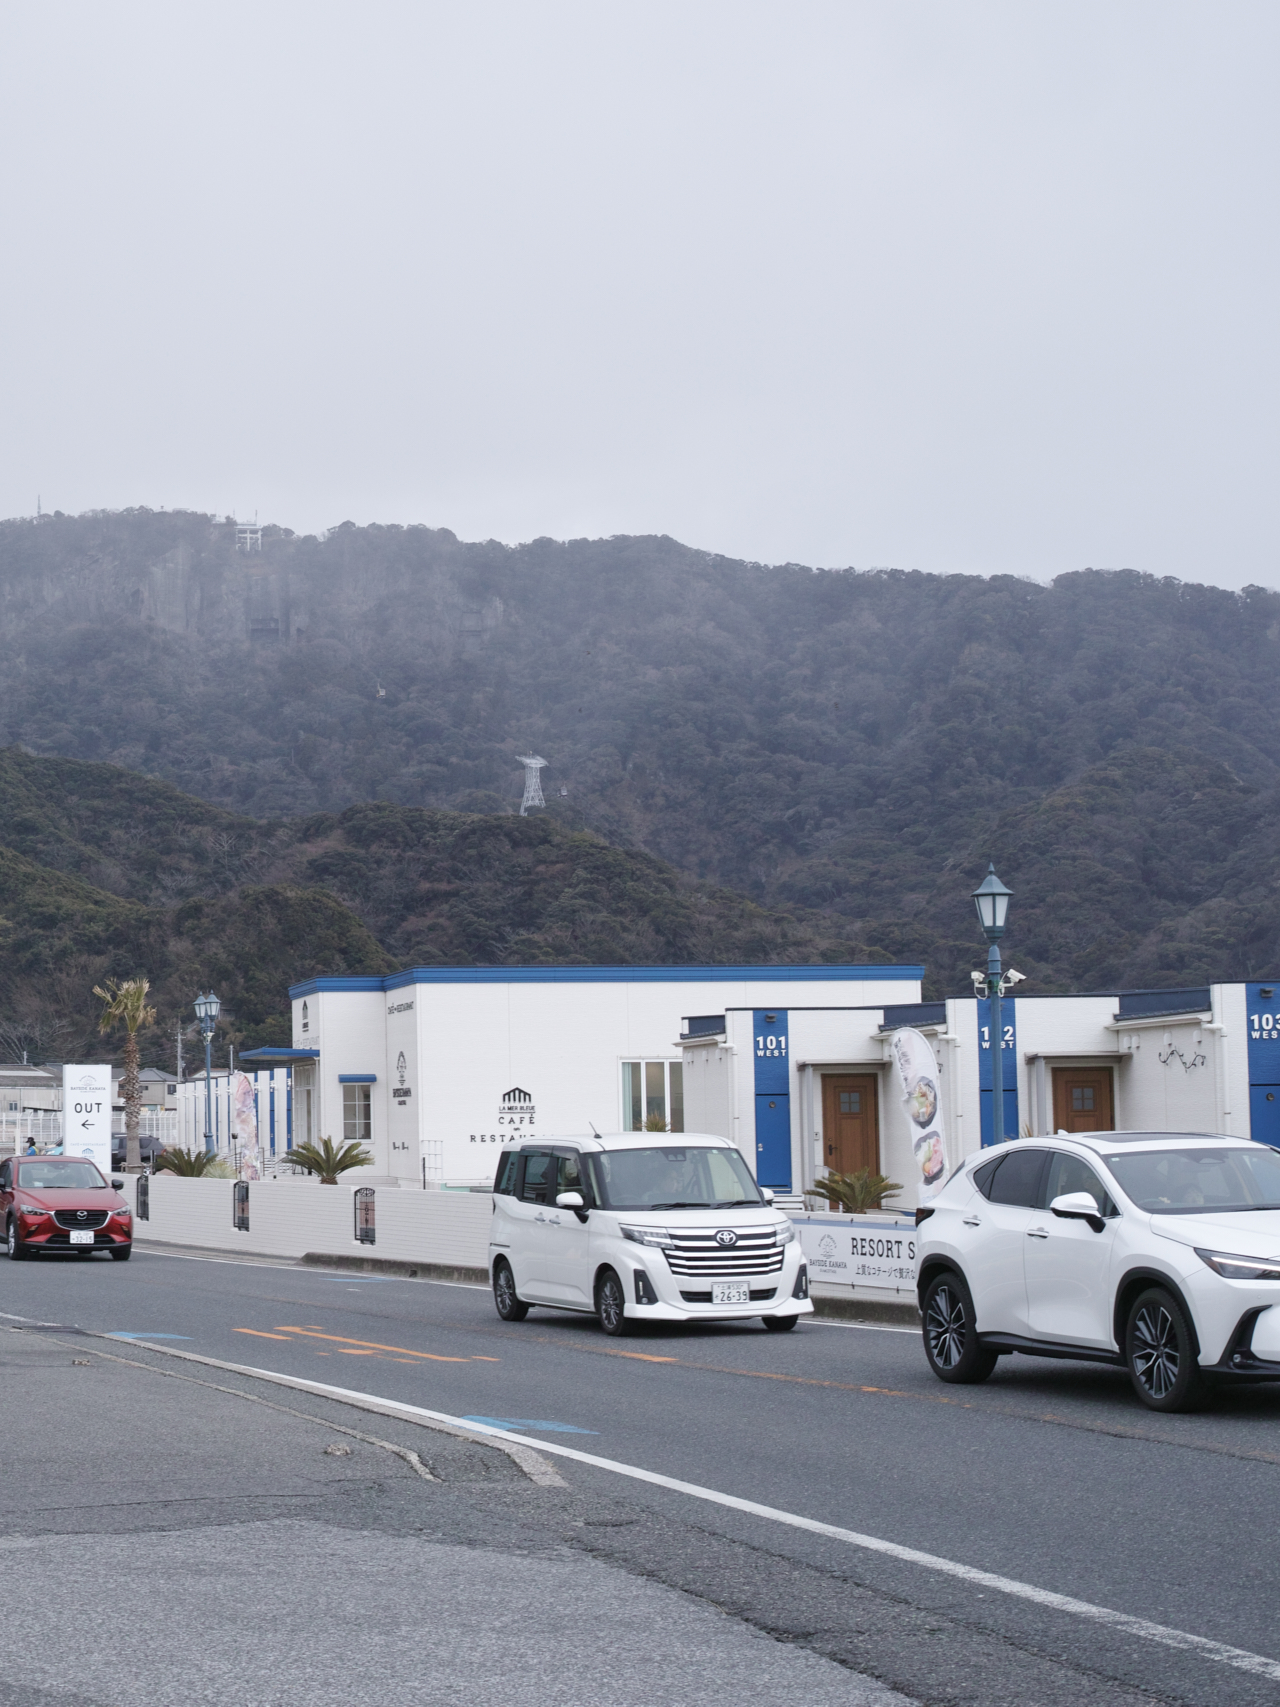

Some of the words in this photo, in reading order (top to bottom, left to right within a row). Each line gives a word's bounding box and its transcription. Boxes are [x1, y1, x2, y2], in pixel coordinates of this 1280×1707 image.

[981, 1026, 1014, 1040] 12
[756, 1036, 785, 1049] 101
[981, 1041, 1014, 1049] WST
[74, 1103, 102, 1113] OUT
[498, 1114, 535, 1124] CAFÉ
[851, 1237, 902, 1259] RESORT
[809, 1259, 828, 1267] BAYSIDE
[829, 1260, 847, 1269] KANAYA
[720, 1291, 747, 1301] 26-39
